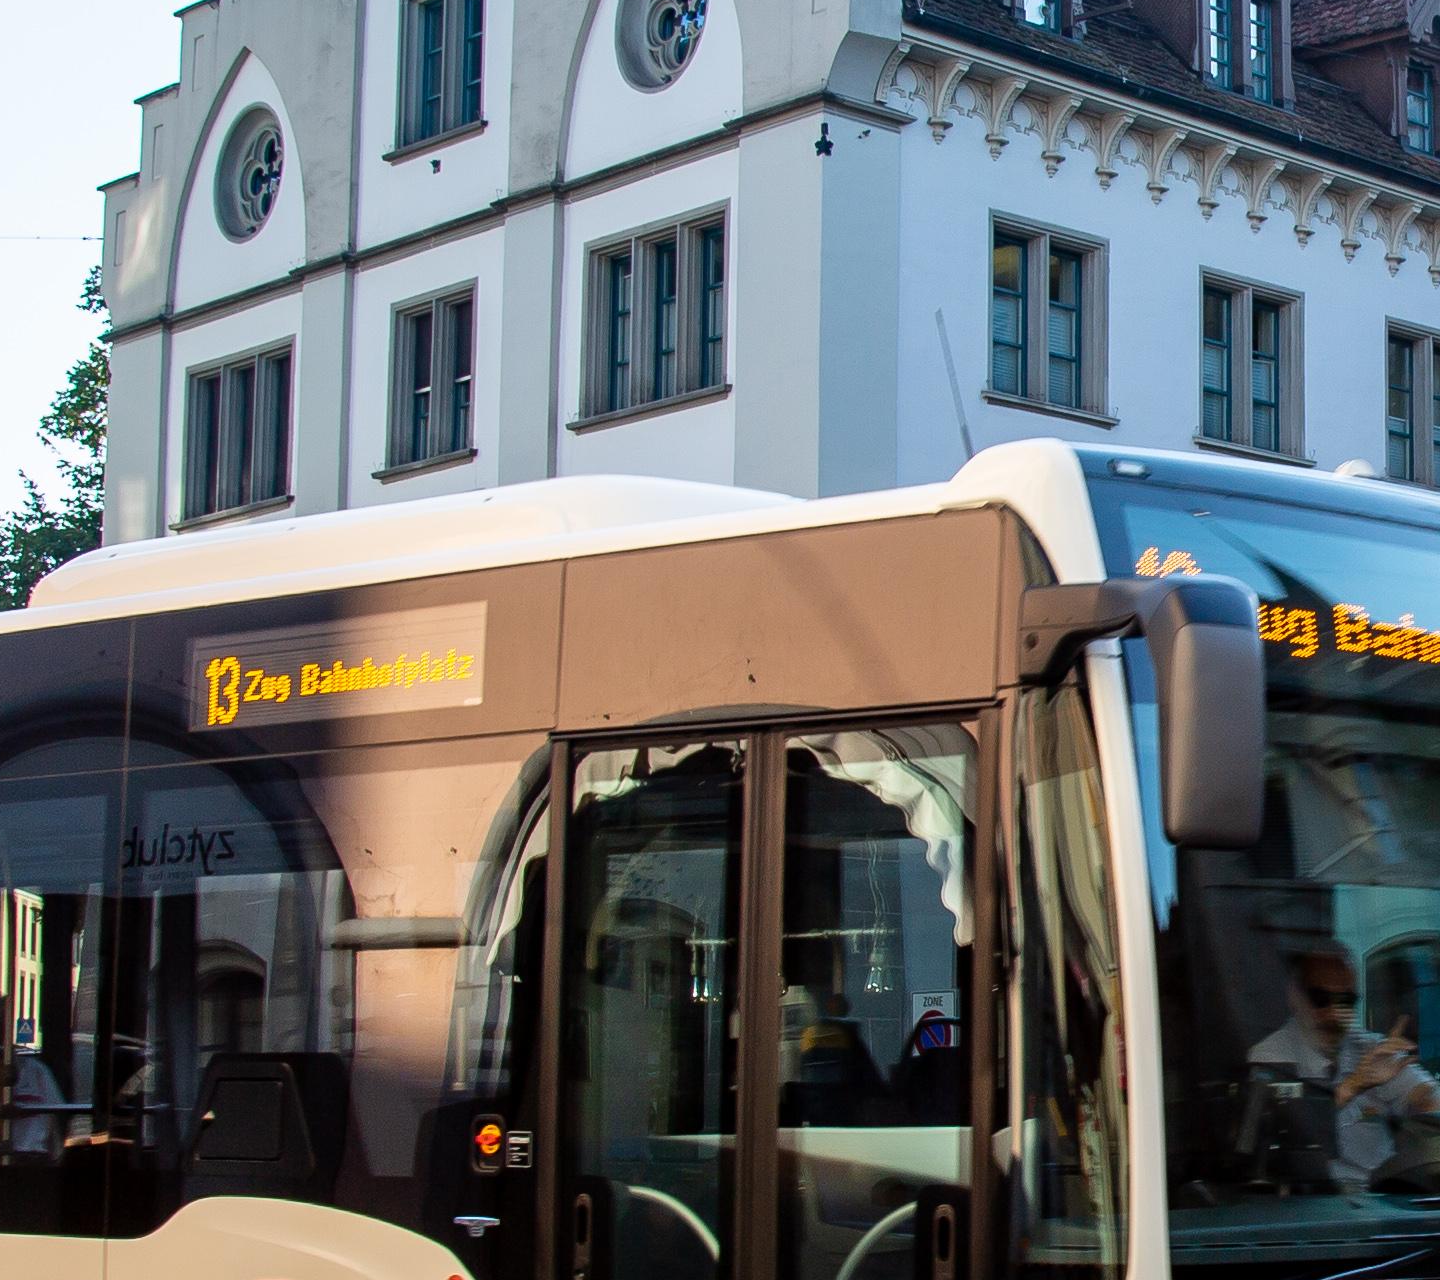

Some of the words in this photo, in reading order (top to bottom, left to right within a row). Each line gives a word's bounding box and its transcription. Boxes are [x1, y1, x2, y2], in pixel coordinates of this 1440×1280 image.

[205, 656, 240, 726] 13
[244, 669, 291, 703] Zug
[300, 647, 474, 696] Bahnhofplatz
[923, 996, 943, 1007] ZONE
